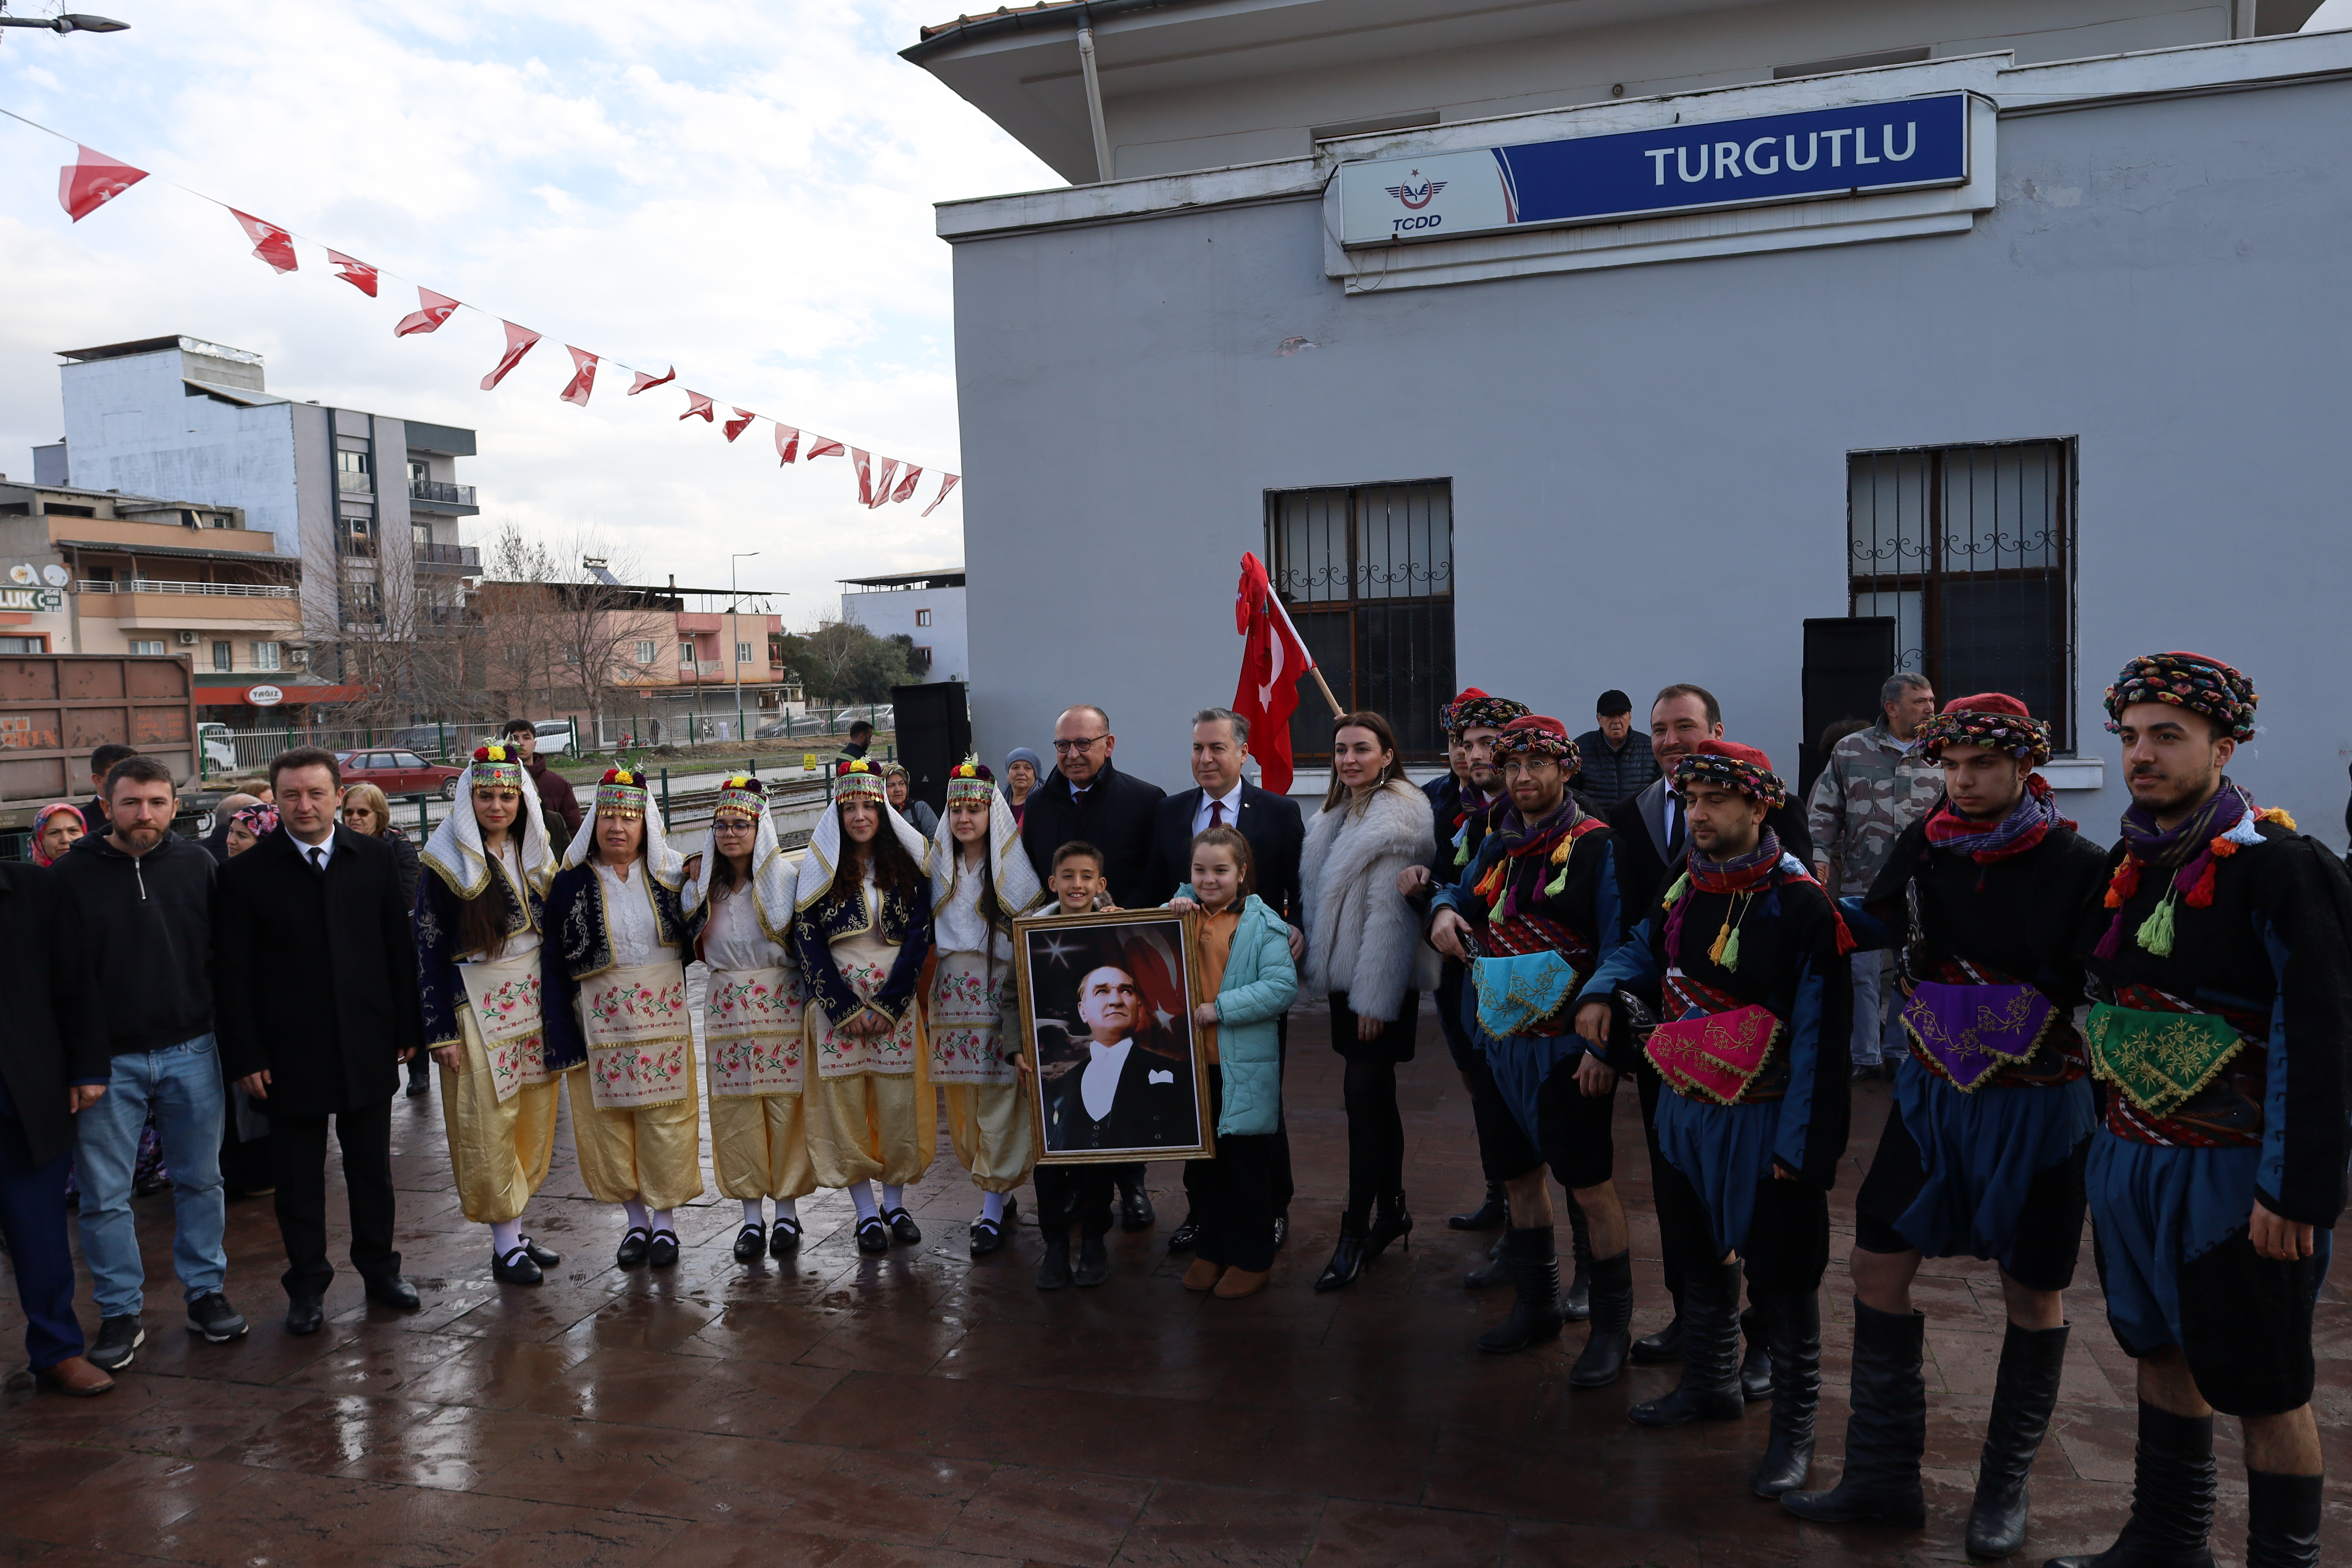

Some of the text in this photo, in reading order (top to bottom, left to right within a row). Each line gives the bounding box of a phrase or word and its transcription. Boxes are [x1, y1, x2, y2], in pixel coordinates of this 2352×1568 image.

[1644, 121, 1916, 185] TURGUTLU
[1393, 215, 1441, 231] TCDD
[0, 590, 37, 608] LUK
